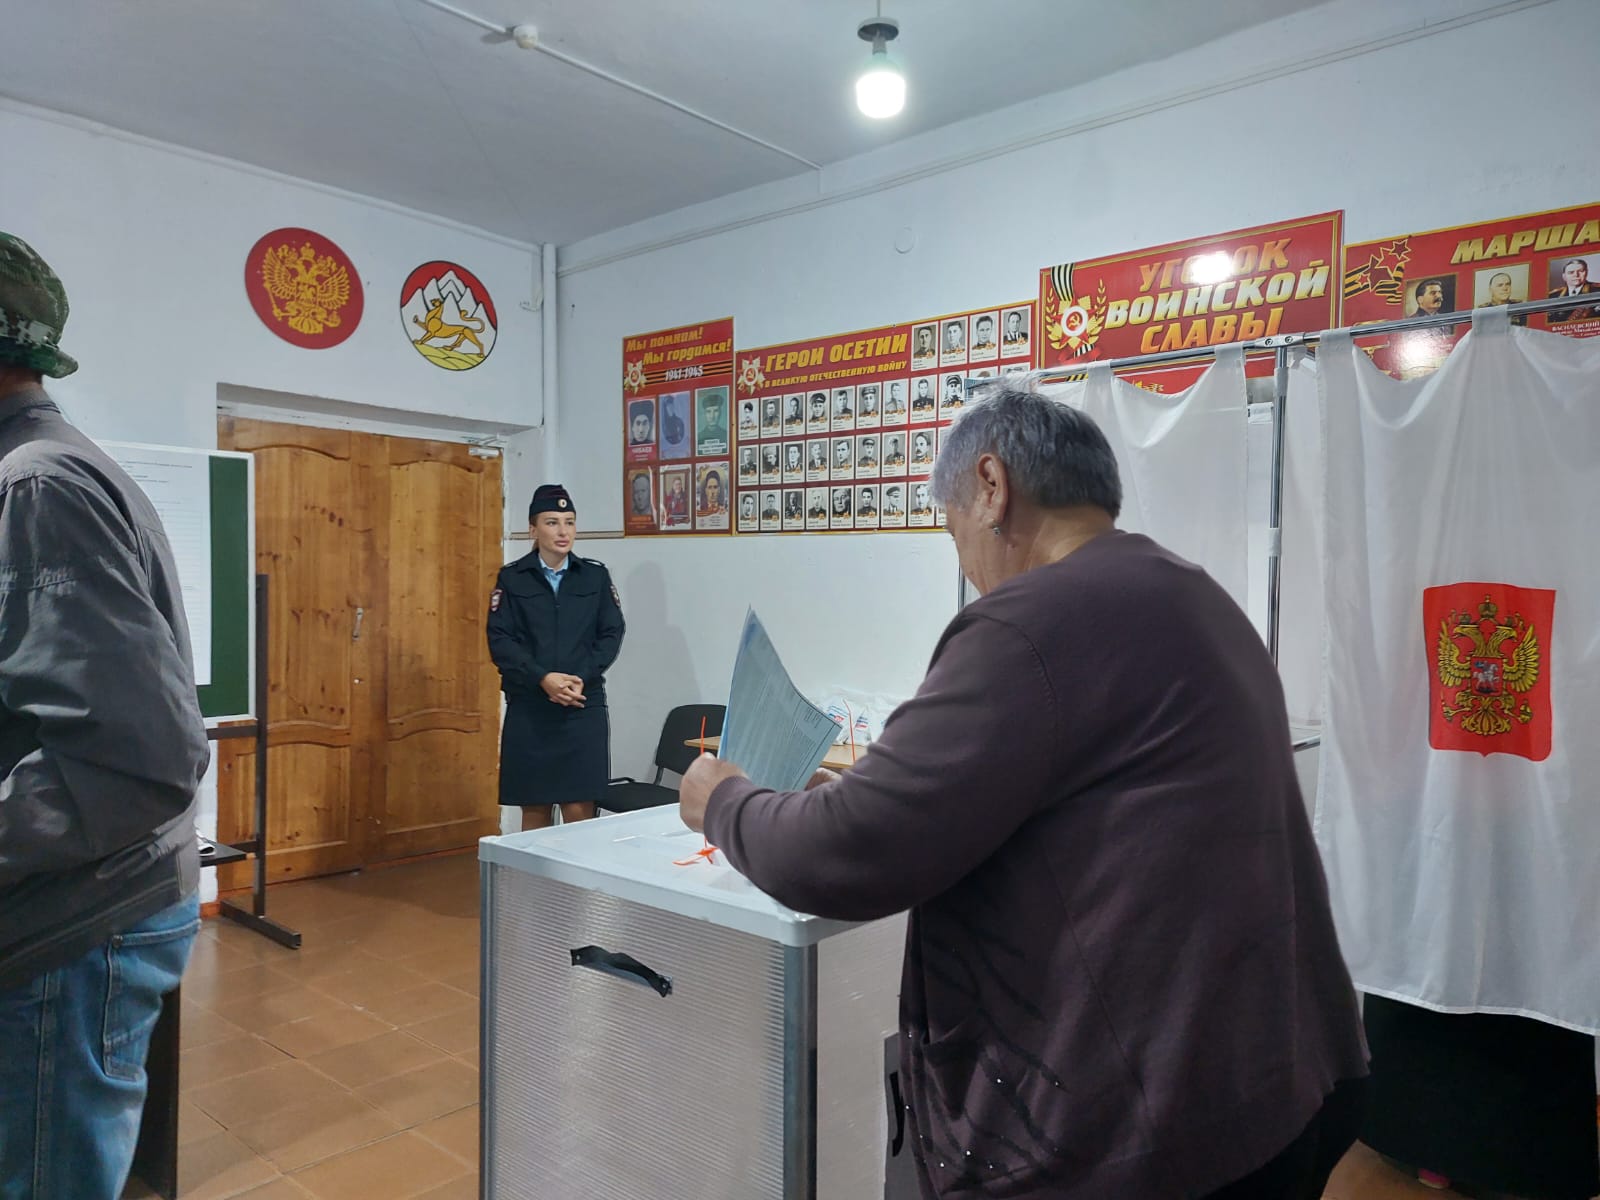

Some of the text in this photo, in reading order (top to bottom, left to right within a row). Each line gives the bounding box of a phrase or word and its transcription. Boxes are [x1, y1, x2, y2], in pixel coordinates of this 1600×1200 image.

[1450, 219, 1600, 264] МАРША
[1104, 260, 1330, 329] ВОИНСКОЙ
[626, 327, 704, 352] Мы помним!
[1140, 307, 1284, 354] СЛАВЫ
[643, 338, 732, 365] Мы гордимся!
[765, 333, 908, 373] ГЕРОИ ОСЕТИИ
[771, 375, 808, 387] ВЕЛИКУЮ
[809, 365, 876, 382] ОТЕЧЕСТВЕННУЮ
